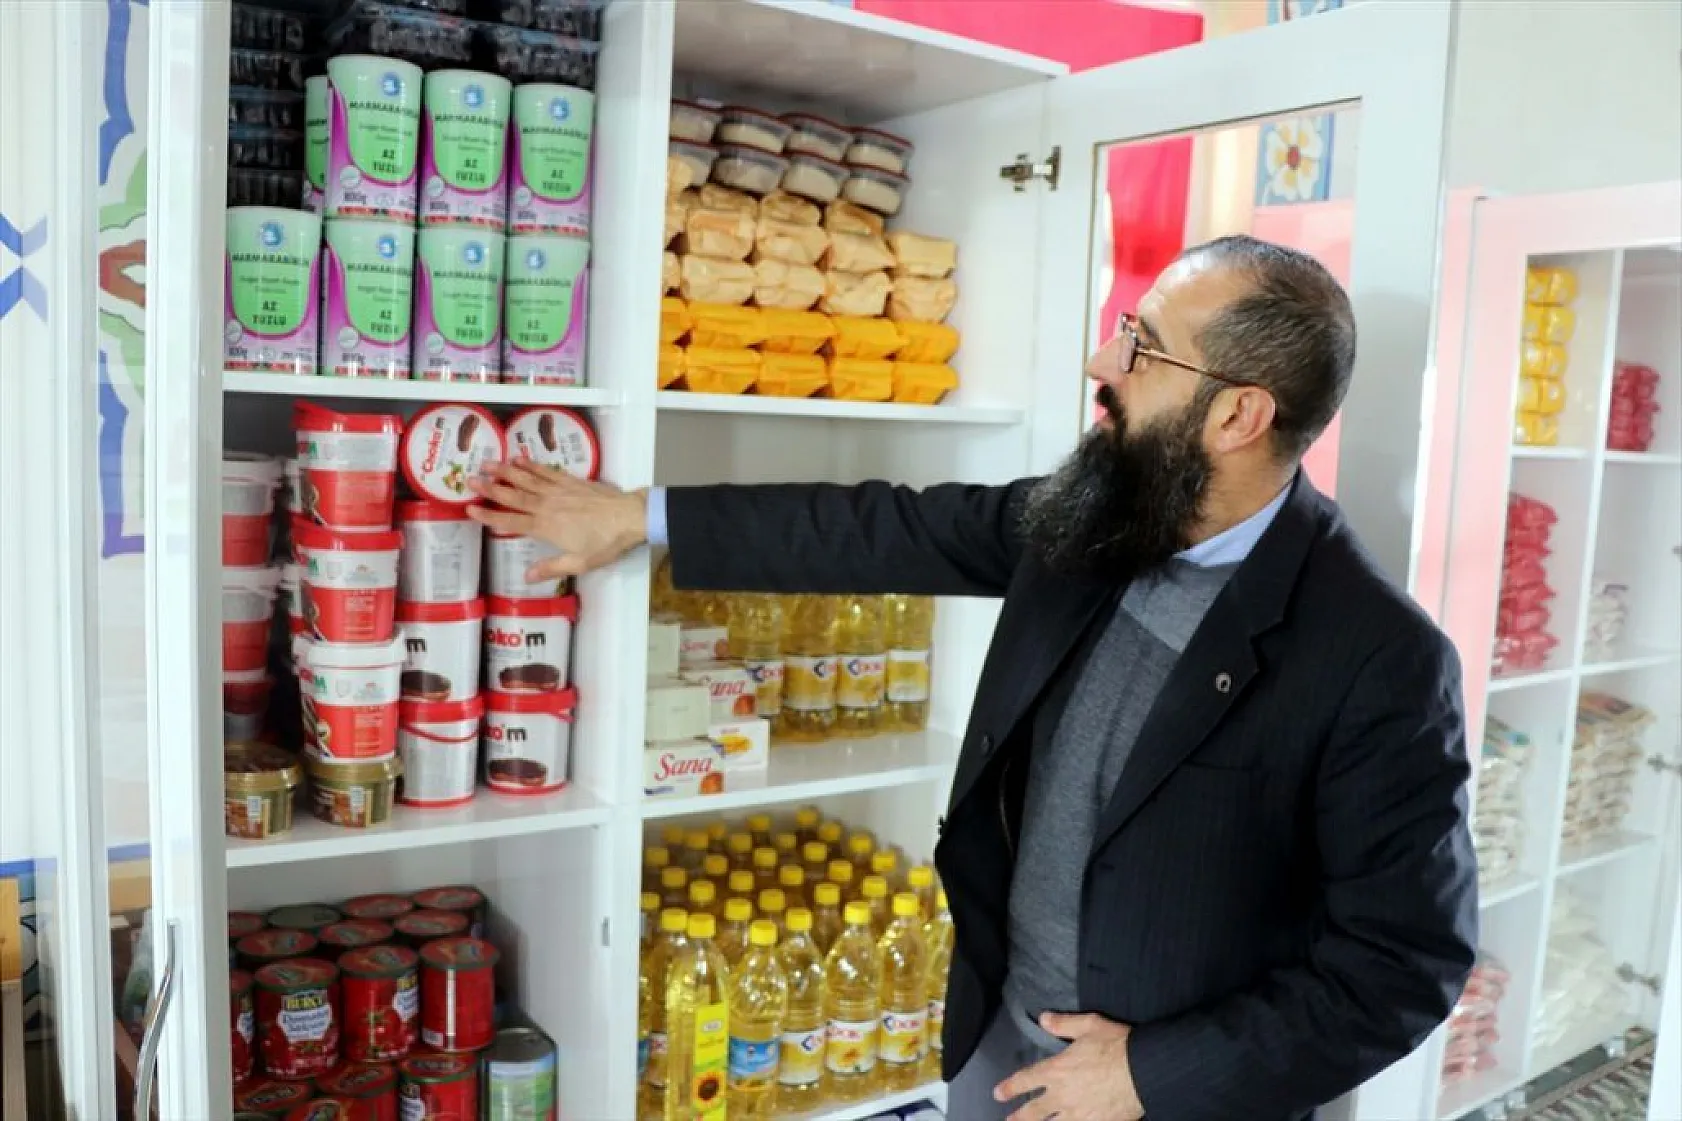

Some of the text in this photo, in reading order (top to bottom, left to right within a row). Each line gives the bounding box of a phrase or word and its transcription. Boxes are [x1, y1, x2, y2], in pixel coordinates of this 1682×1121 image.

[464, 158, 477, 168] AZ
[263, 300, 276, 311] AZ
[253, 314, 286, 325] TUZLU
[710, 680, 746, 697] ana
[654, 752, 713, 781] Sana
